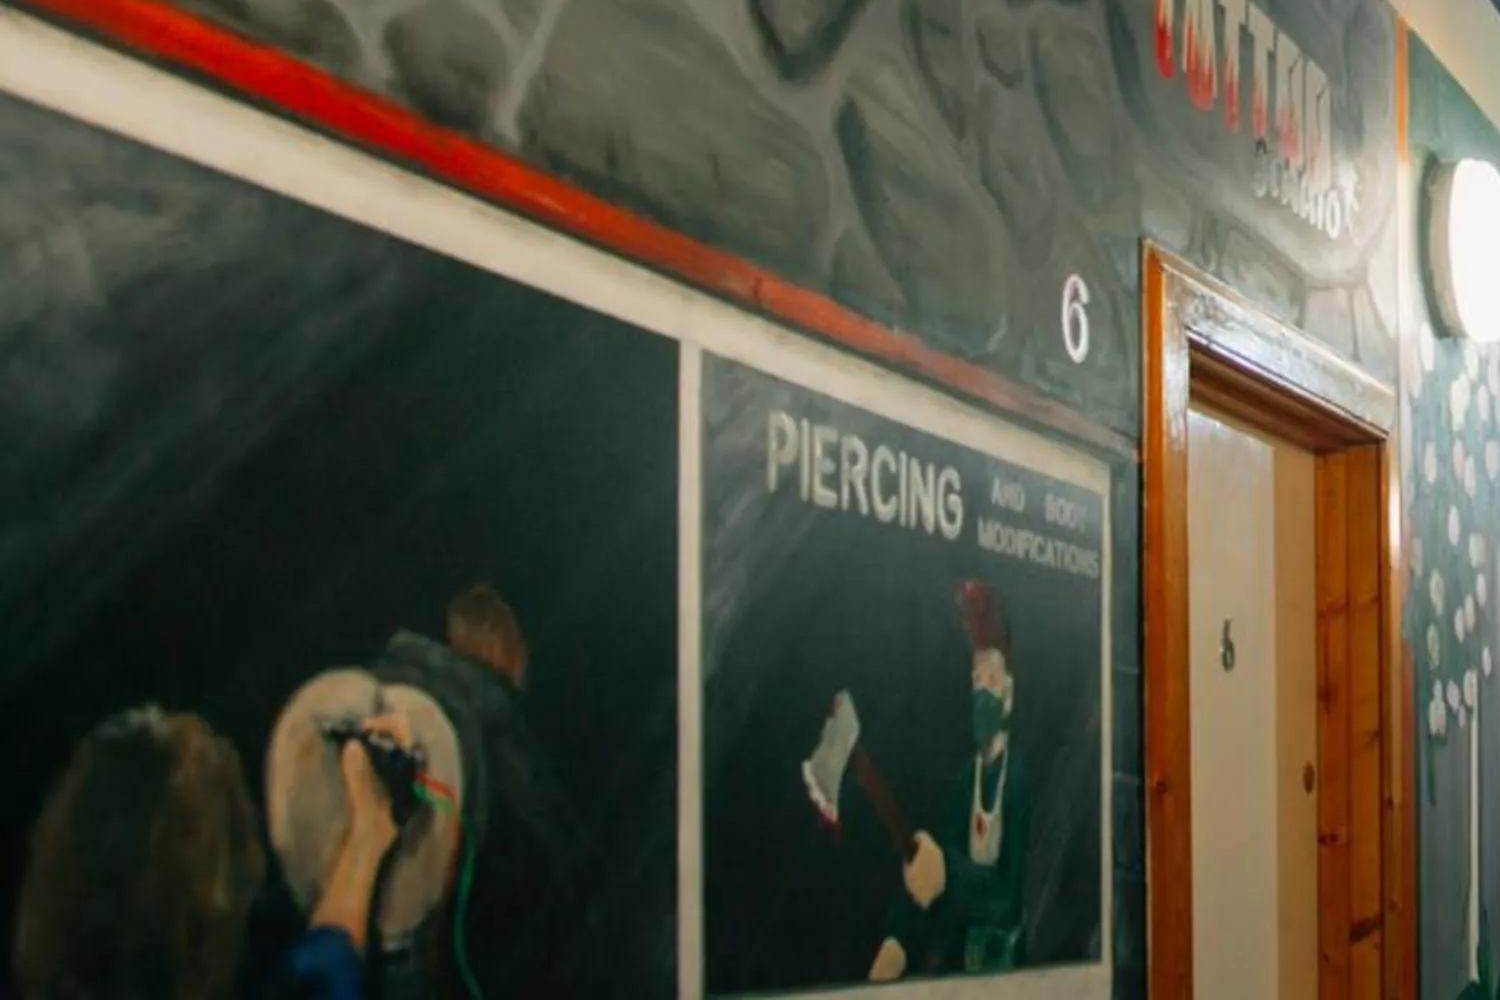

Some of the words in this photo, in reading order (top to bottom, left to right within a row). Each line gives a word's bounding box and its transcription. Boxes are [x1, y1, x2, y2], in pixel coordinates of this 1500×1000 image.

[1061, 272, 1090, 364] 6
[767, 410, 964, 541] PIERCING
[977, 514, 1100, 579] MODIFICATIONS
